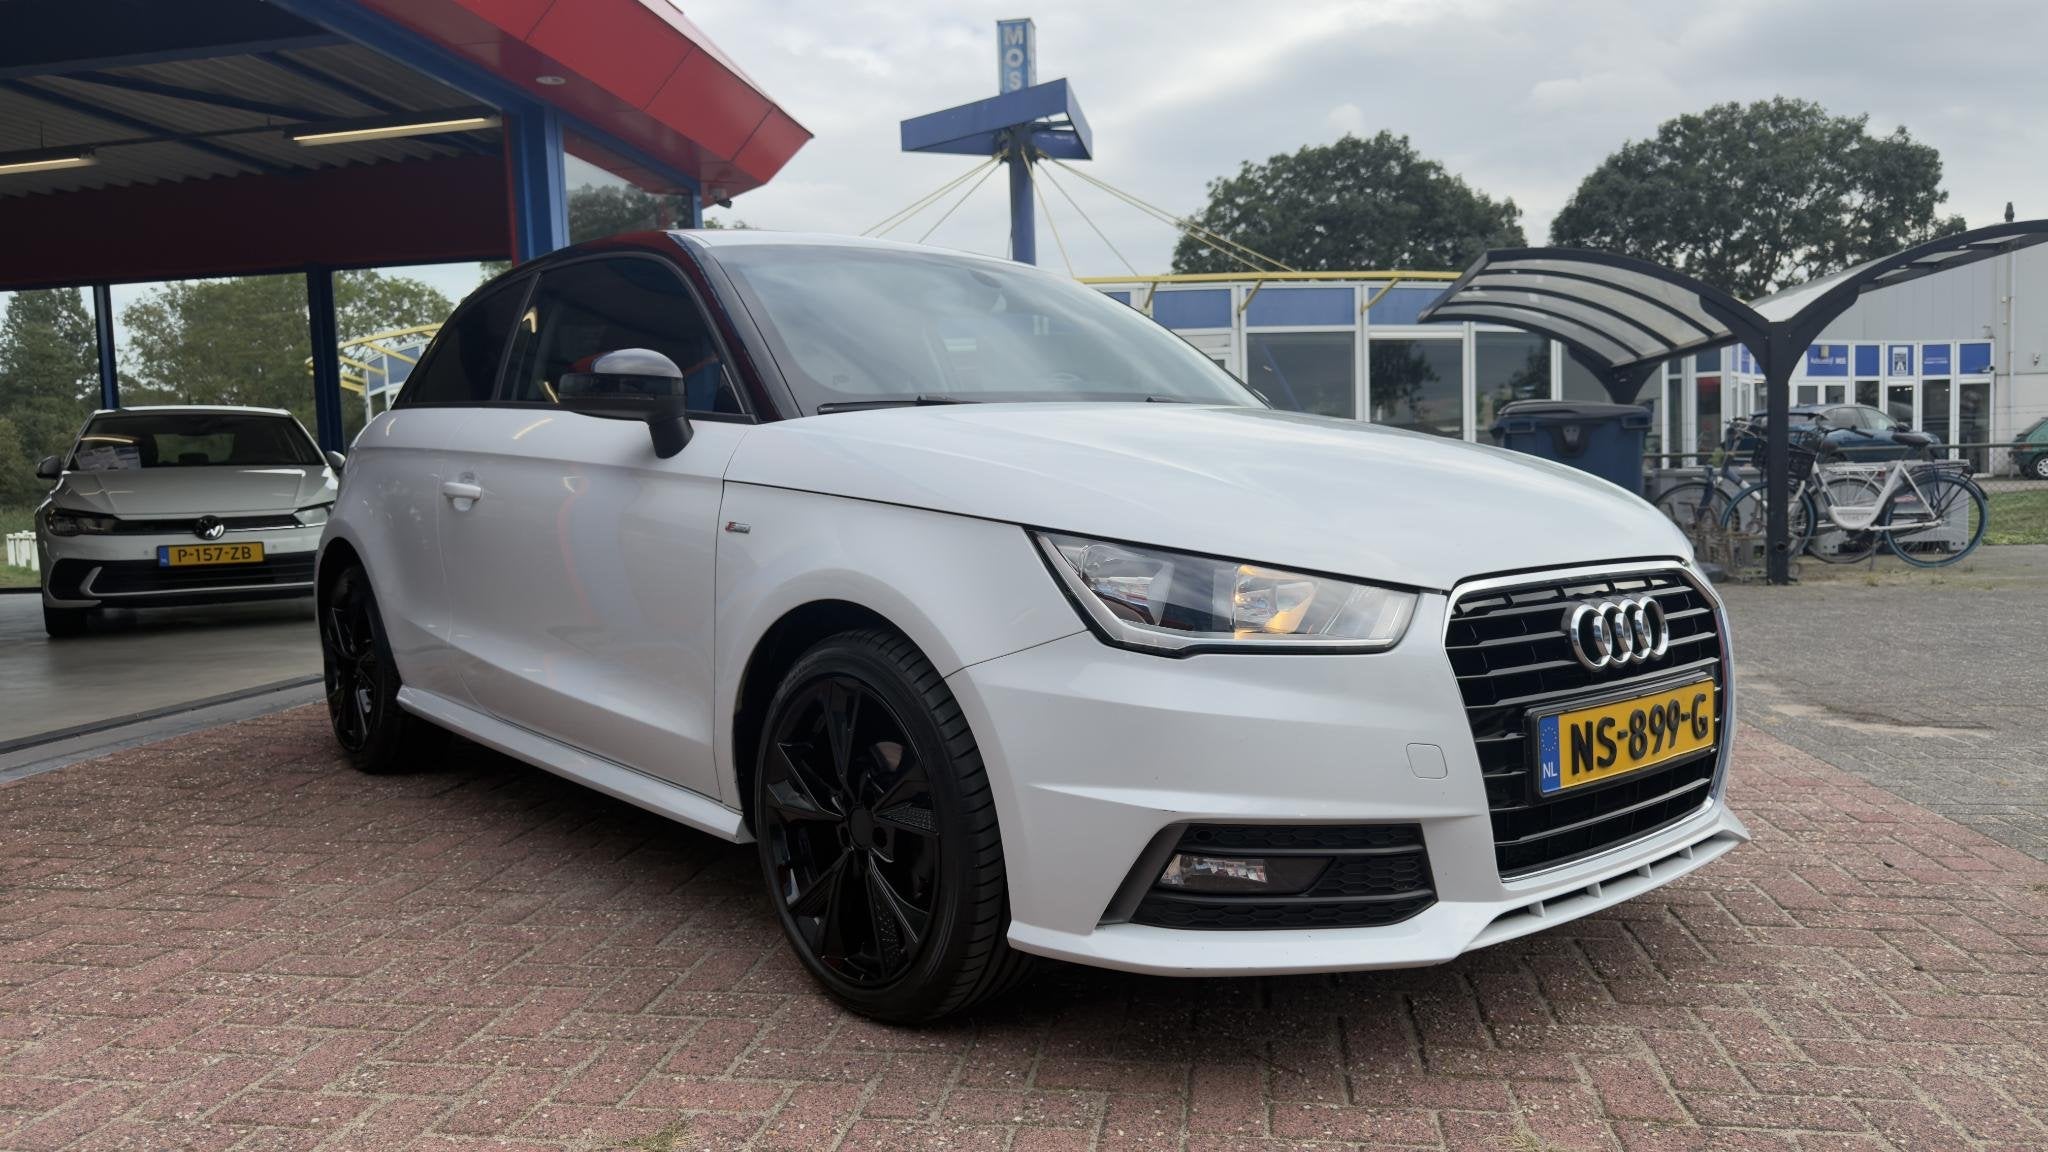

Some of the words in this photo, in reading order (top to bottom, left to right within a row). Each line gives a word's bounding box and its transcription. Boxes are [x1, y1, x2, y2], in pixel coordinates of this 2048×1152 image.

[1004, 26, 1024, 90] MOS
[177, 546, 252, 563] P-157-ZB
[1570, 693, 1709, 776] NS-899-G
[1543, 762, 1558, 779] NL
